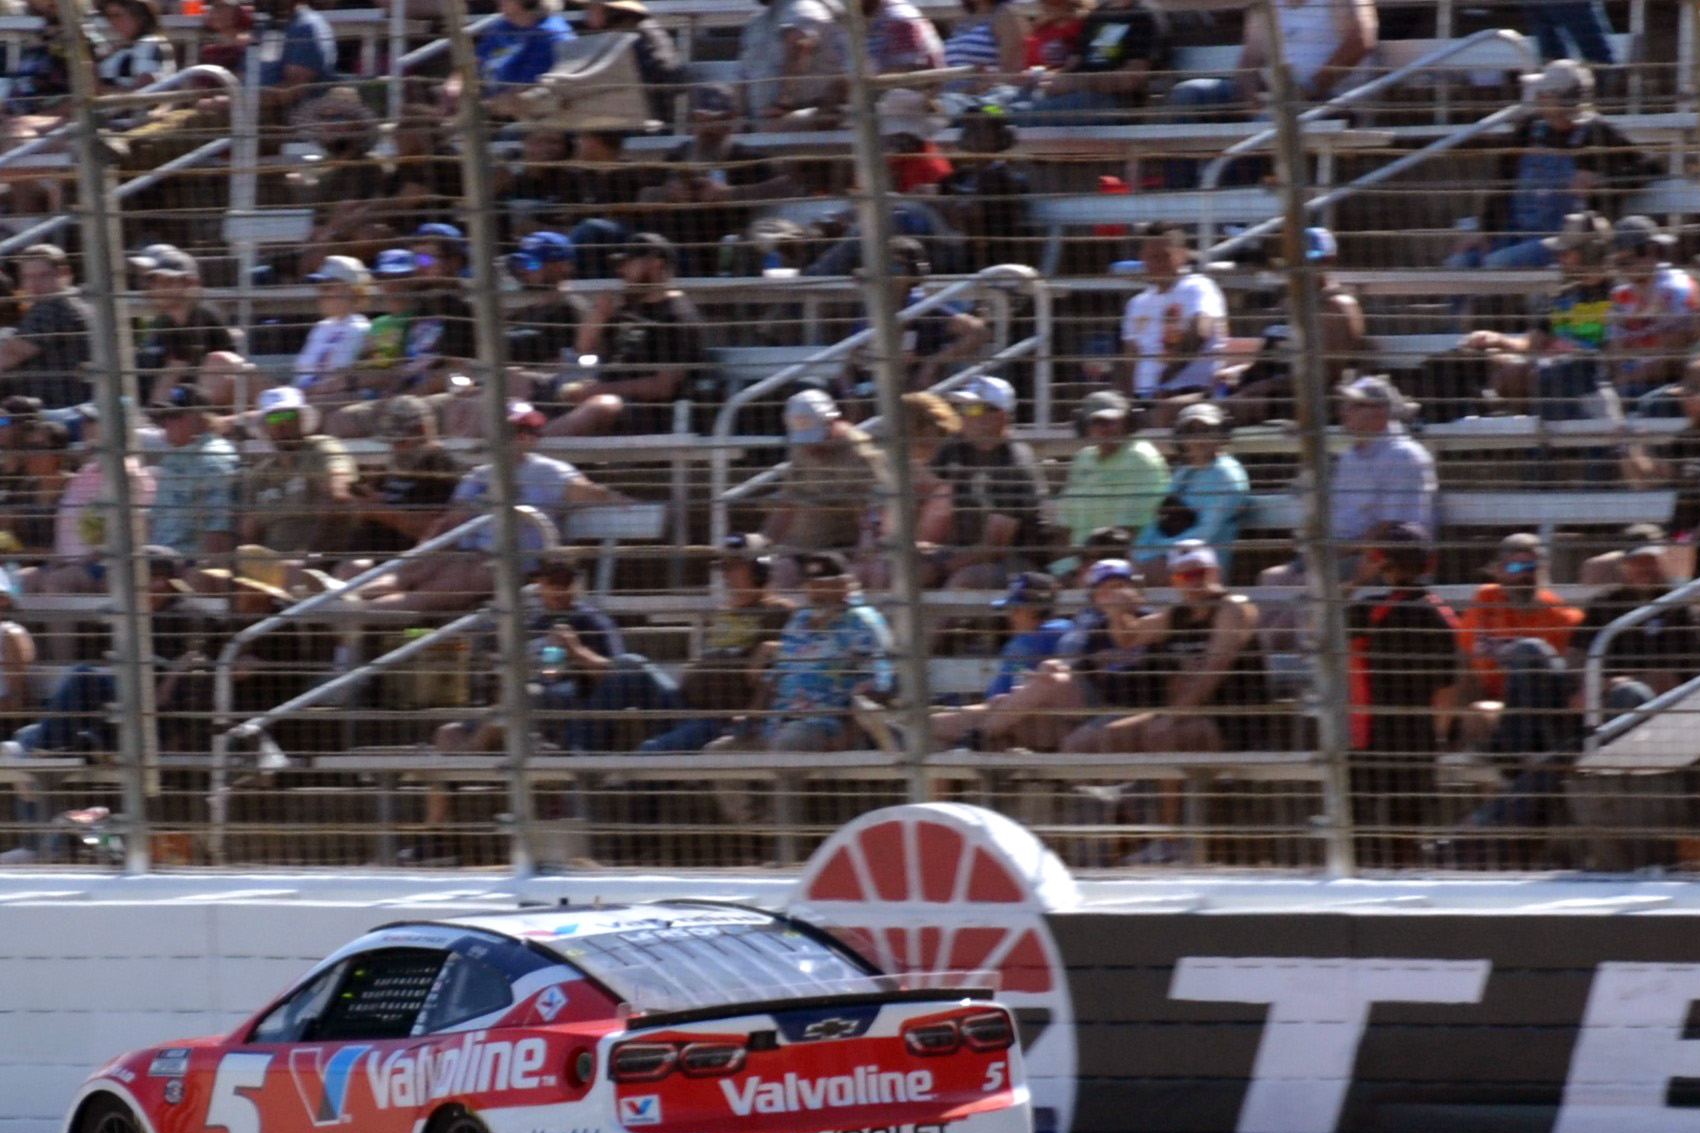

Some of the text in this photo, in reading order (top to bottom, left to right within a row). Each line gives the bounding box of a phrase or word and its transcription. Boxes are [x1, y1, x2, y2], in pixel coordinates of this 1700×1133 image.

[366, 1029, 547, 1110] Valvoline
[718, 1064, 934, 1117] Valvoline
[981, 1061, 1005, 1092] 5
